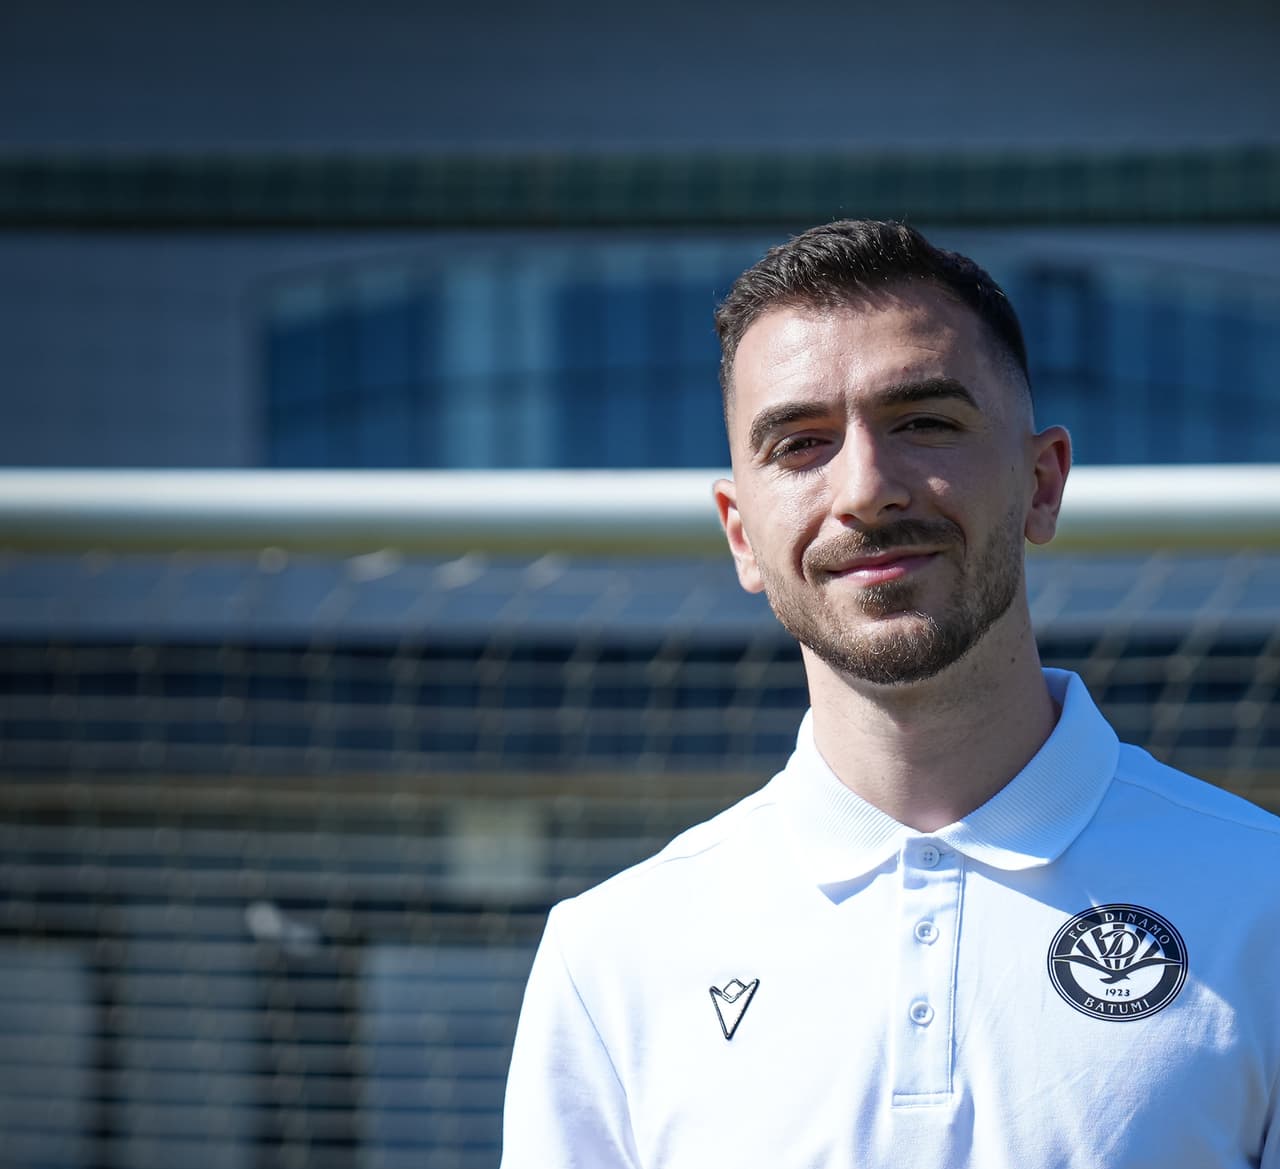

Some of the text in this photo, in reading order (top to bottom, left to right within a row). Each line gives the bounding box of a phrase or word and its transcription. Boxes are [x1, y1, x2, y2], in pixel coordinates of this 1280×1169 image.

[1068, 912, 1170, 945] FC DINAMO
[1105, 988, 1131, 997] 1923
[1084, 996, 1150, 1014] BATUMI
